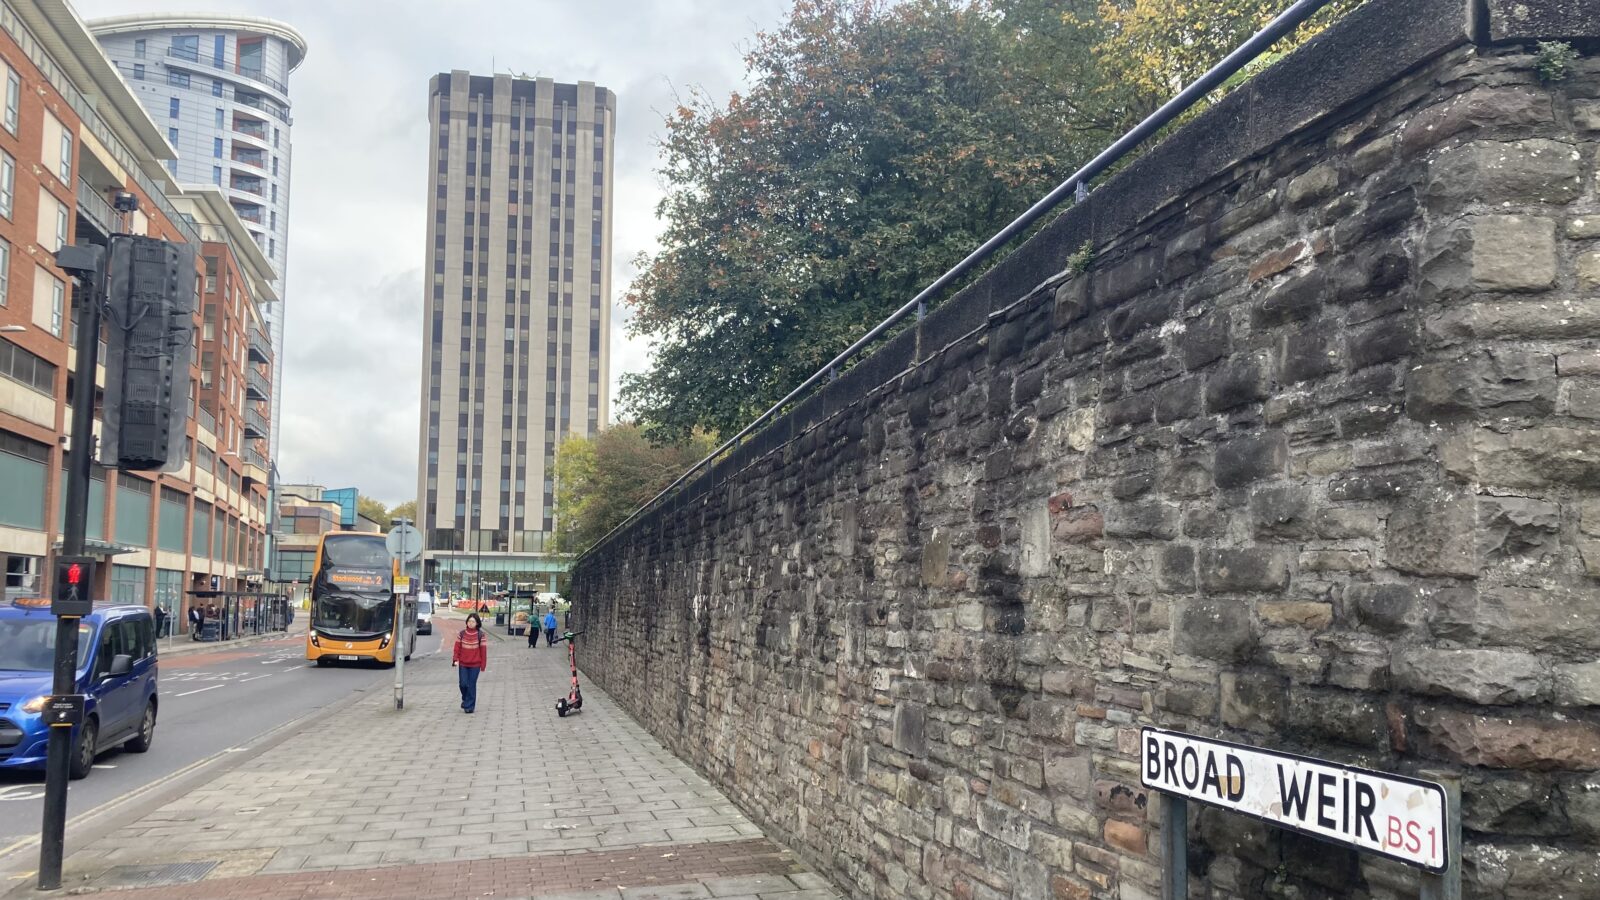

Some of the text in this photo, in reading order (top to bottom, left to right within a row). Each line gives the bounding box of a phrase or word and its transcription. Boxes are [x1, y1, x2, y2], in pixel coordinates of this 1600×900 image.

[376, 576, 382, 585] 2
[1146, 737, 1379, 843] BROAD WEIR
[1387, 815, 1437, 859] BS1
